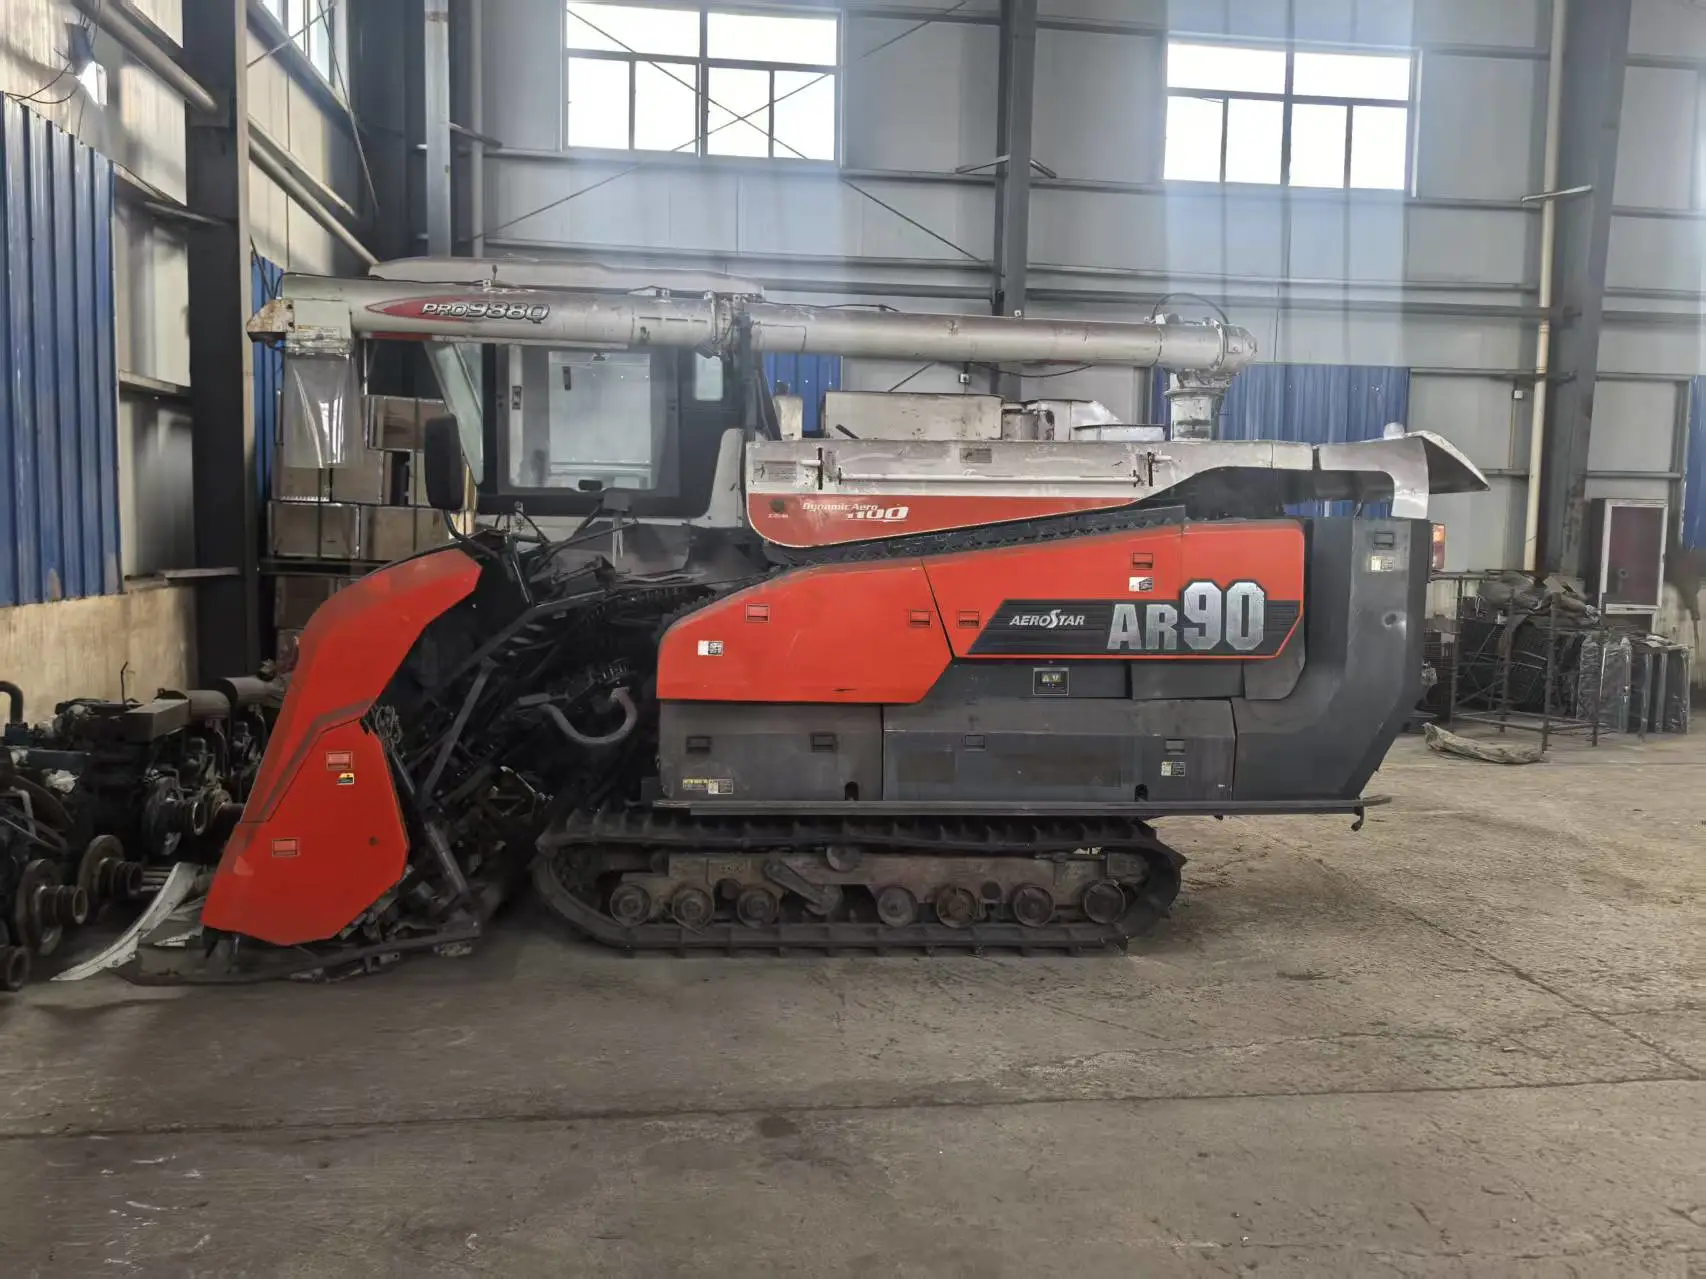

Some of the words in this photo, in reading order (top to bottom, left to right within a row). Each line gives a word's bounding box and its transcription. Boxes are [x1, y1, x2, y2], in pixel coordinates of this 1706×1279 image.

[421, 301, 550, 324] PRO988Q
[802, 502, 850, 512] Dynamic
[851, 503, 878, 511] Aero
[1106, 580, 1265, 650] AR90
